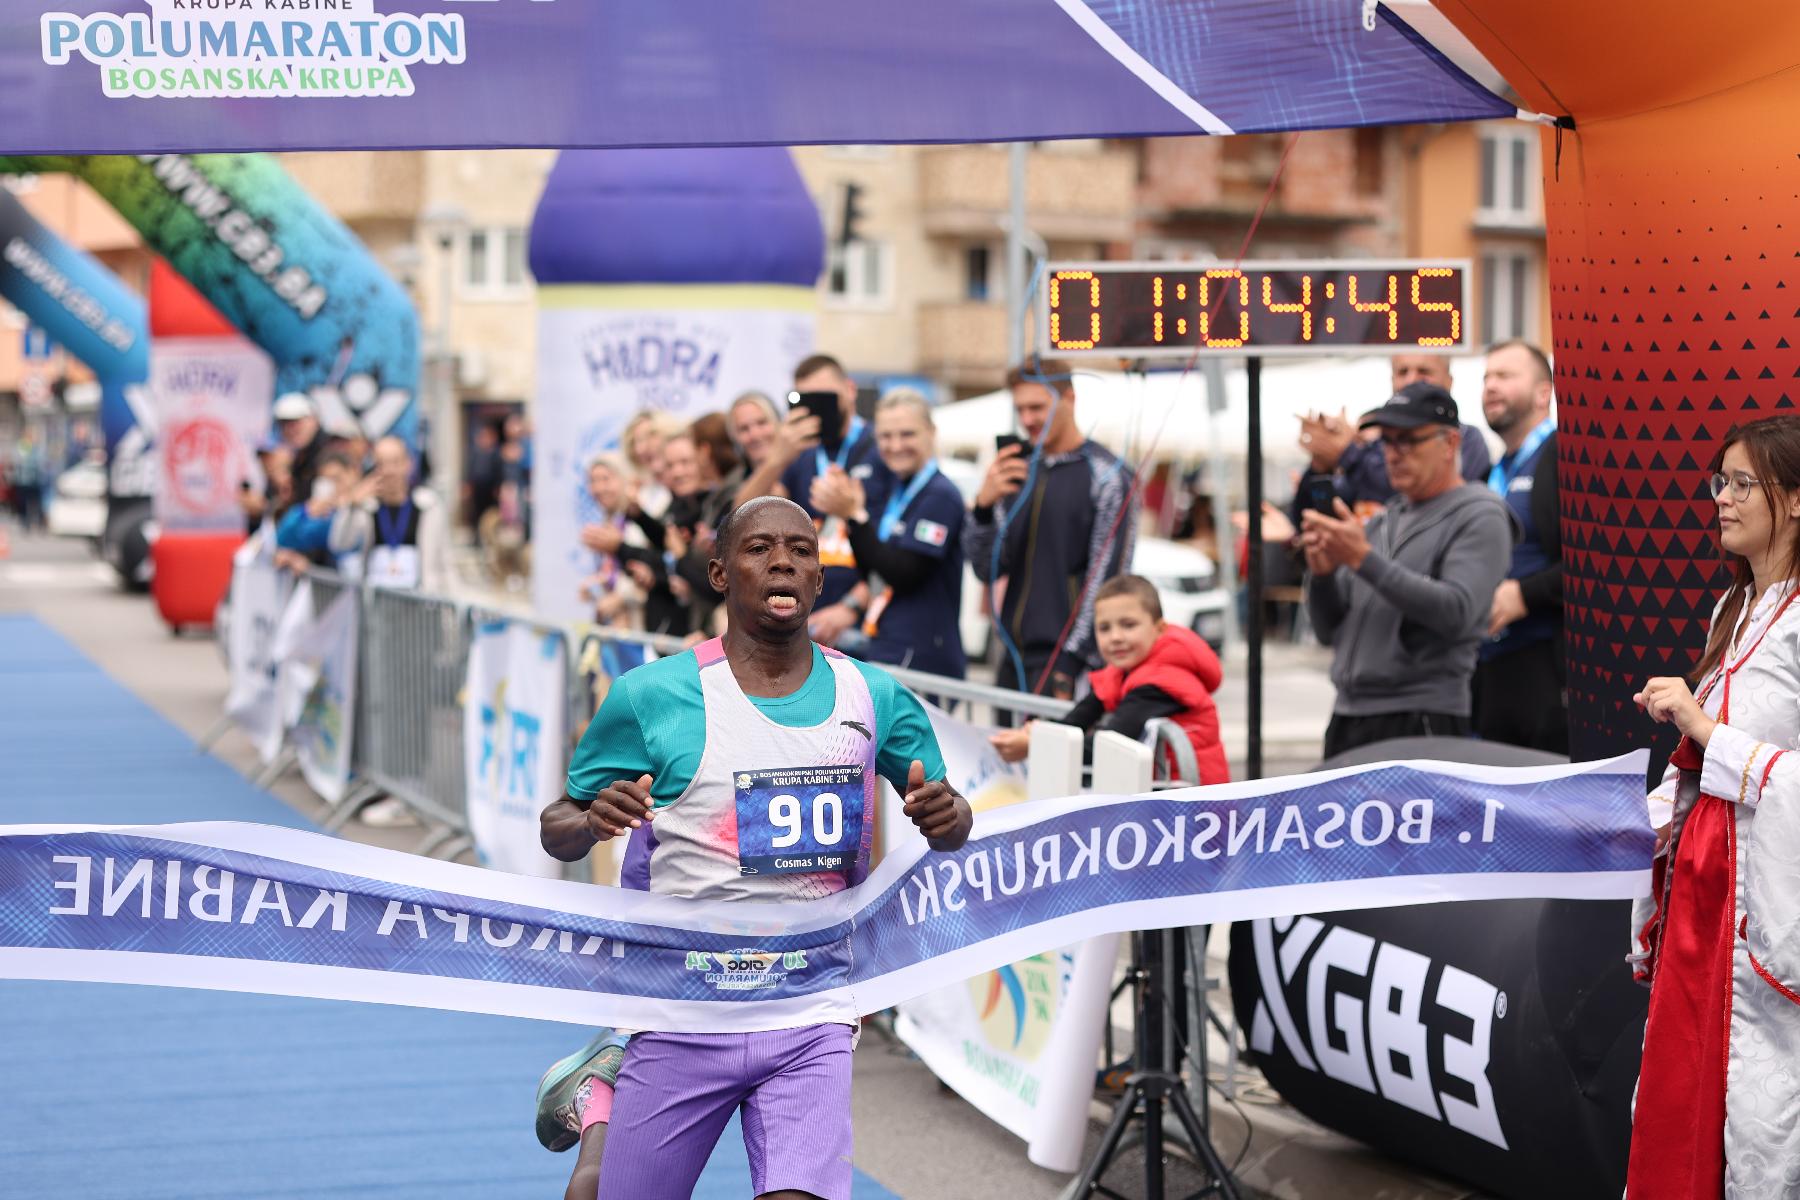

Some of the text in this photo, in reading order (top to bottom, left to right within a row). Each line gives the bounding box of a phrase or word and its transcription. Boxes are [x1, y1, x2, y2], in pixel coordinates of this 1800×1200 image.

[173, 0, 353, 10] KRUPA KABINE
[48, 19, 459, 58] POLUMARATON
[108, 67, 407, 91] BOSANSKA KRUPA
[773, 774, 849, 786] KRUPA KABINE 21K
[768, 792, 843, 848] 90
[774, 856, 842, 868] Cosmas Kigen
